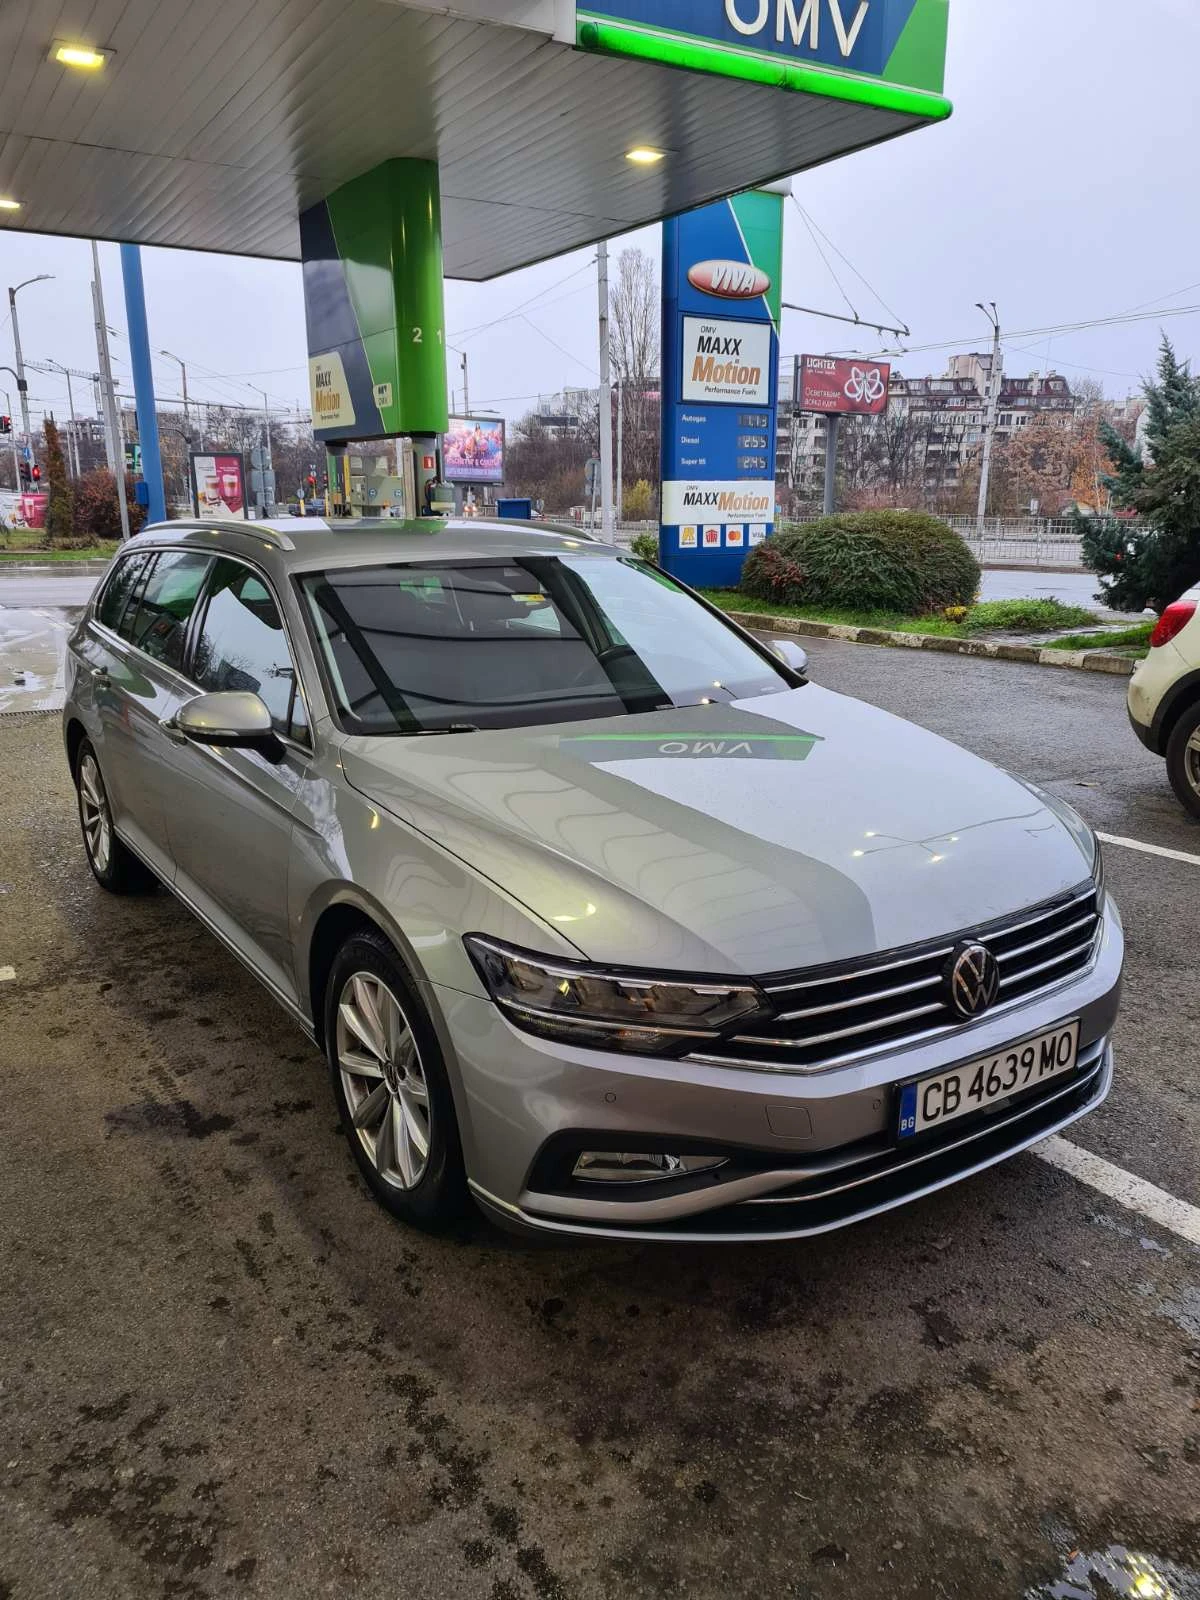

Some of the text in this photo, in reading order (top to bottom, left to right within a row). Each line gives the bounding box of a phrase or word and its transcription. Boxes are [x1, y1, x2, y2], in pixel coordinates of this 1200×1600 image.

[725, 0, 869, 57] OMV
[711, 266, 757, 294] VIVA
[412, 327, 422, 343] 2
[436, 329, 442, 345] 1
[697, 335, 742, 356] MAXX
[692, 355, 762, 386] Motion
[806, 358, 836, 369] LIGHTEX
[315, 388, 340, 413] Motion
[705, 385, 741, 396] Performance
[683, 491, 770, 511] MAXX Motion
[922, 1031, 1073, 1122] CB 4639 MO
[900, 1116, 915, 1131] BG
